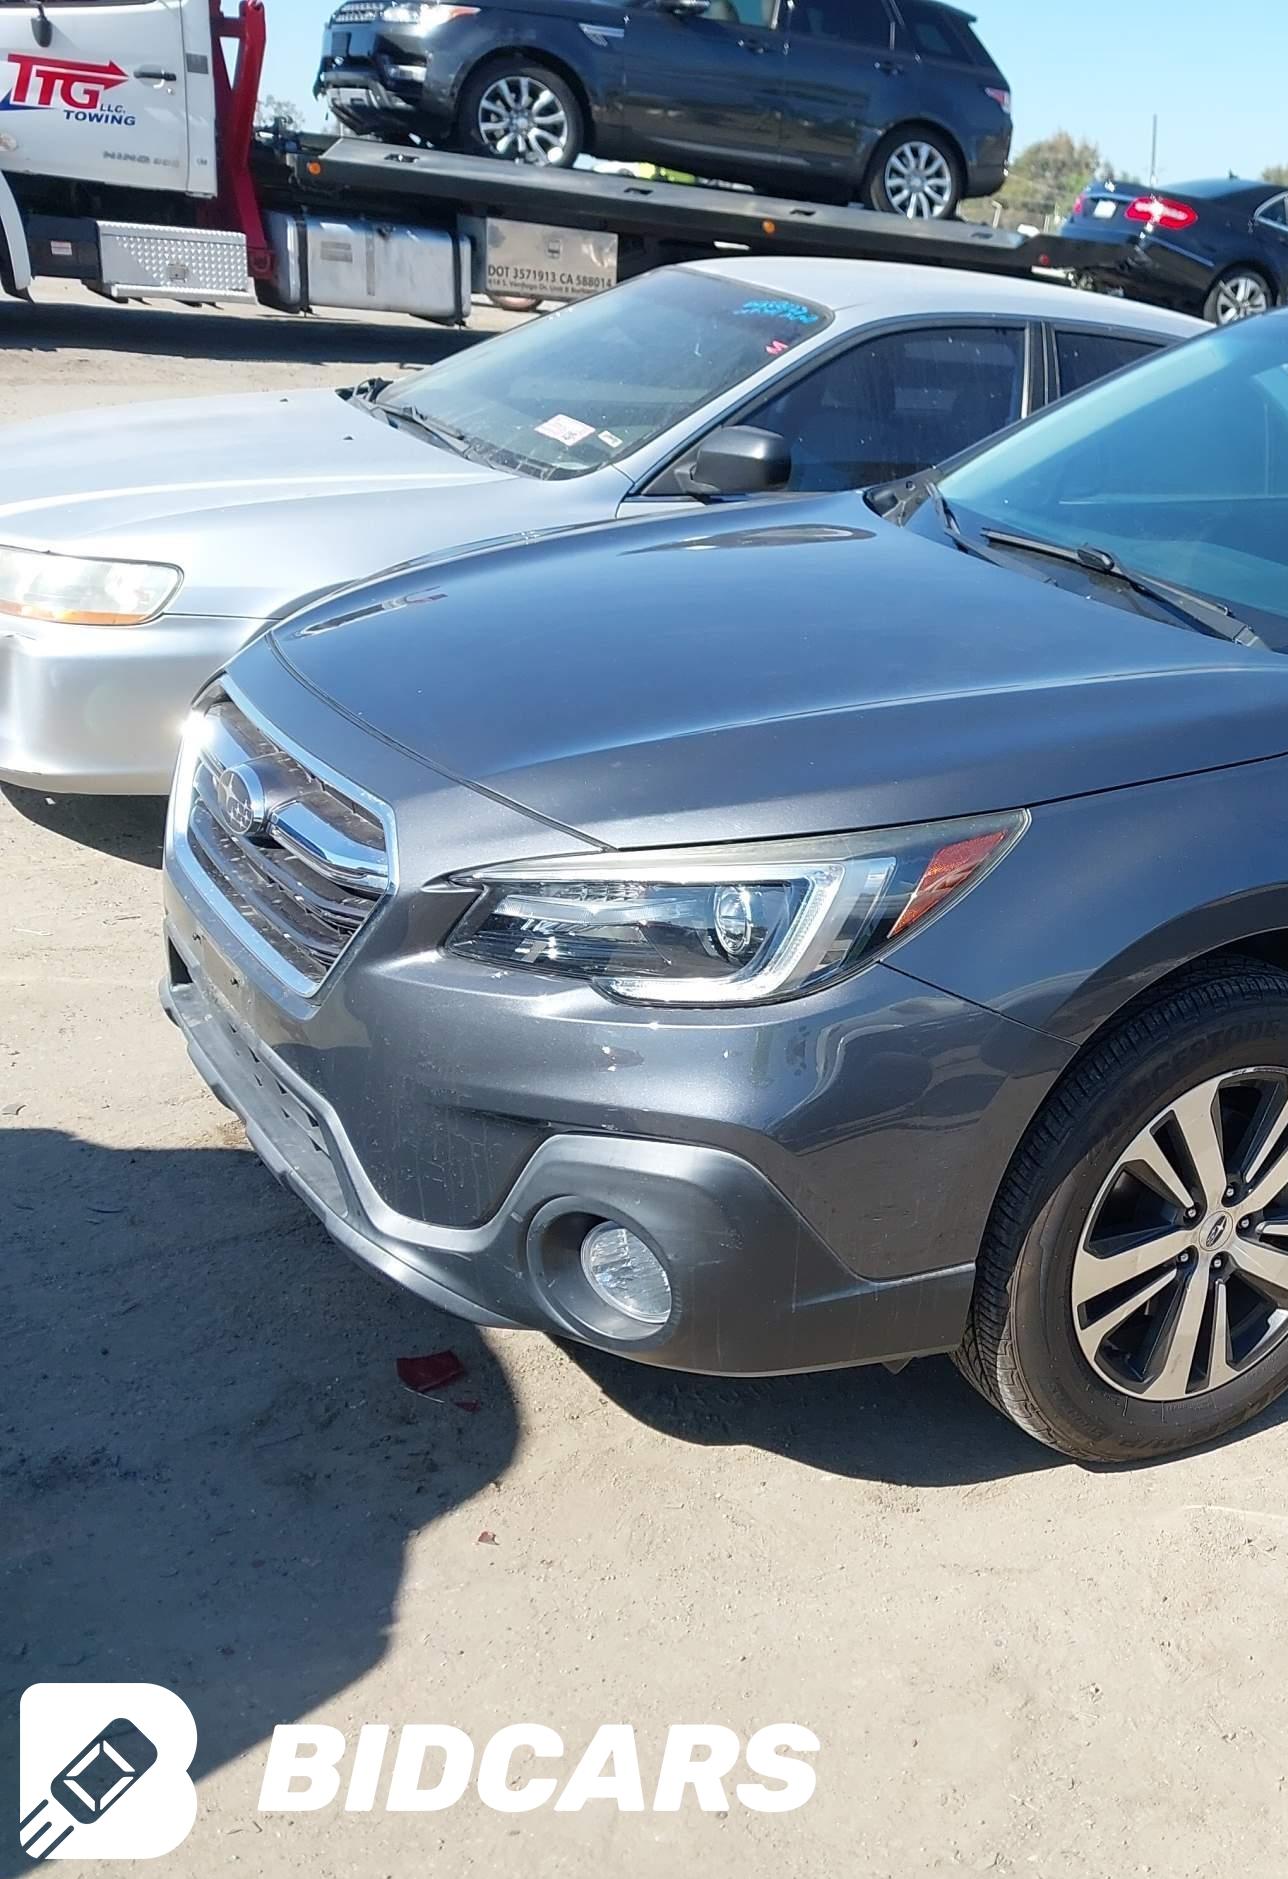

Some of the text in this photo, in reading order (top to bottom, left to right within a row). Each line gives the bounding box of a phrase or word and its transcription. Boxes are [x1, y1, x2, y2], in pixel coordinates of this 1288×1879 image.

[7, 53, 128, 110] TTG
[63, 109, 137, 126] TOWING
[488, 265, 509, 278] DOT
[513, 268, 556, 282] 3571913
[560, 273, 573, 285] CA
